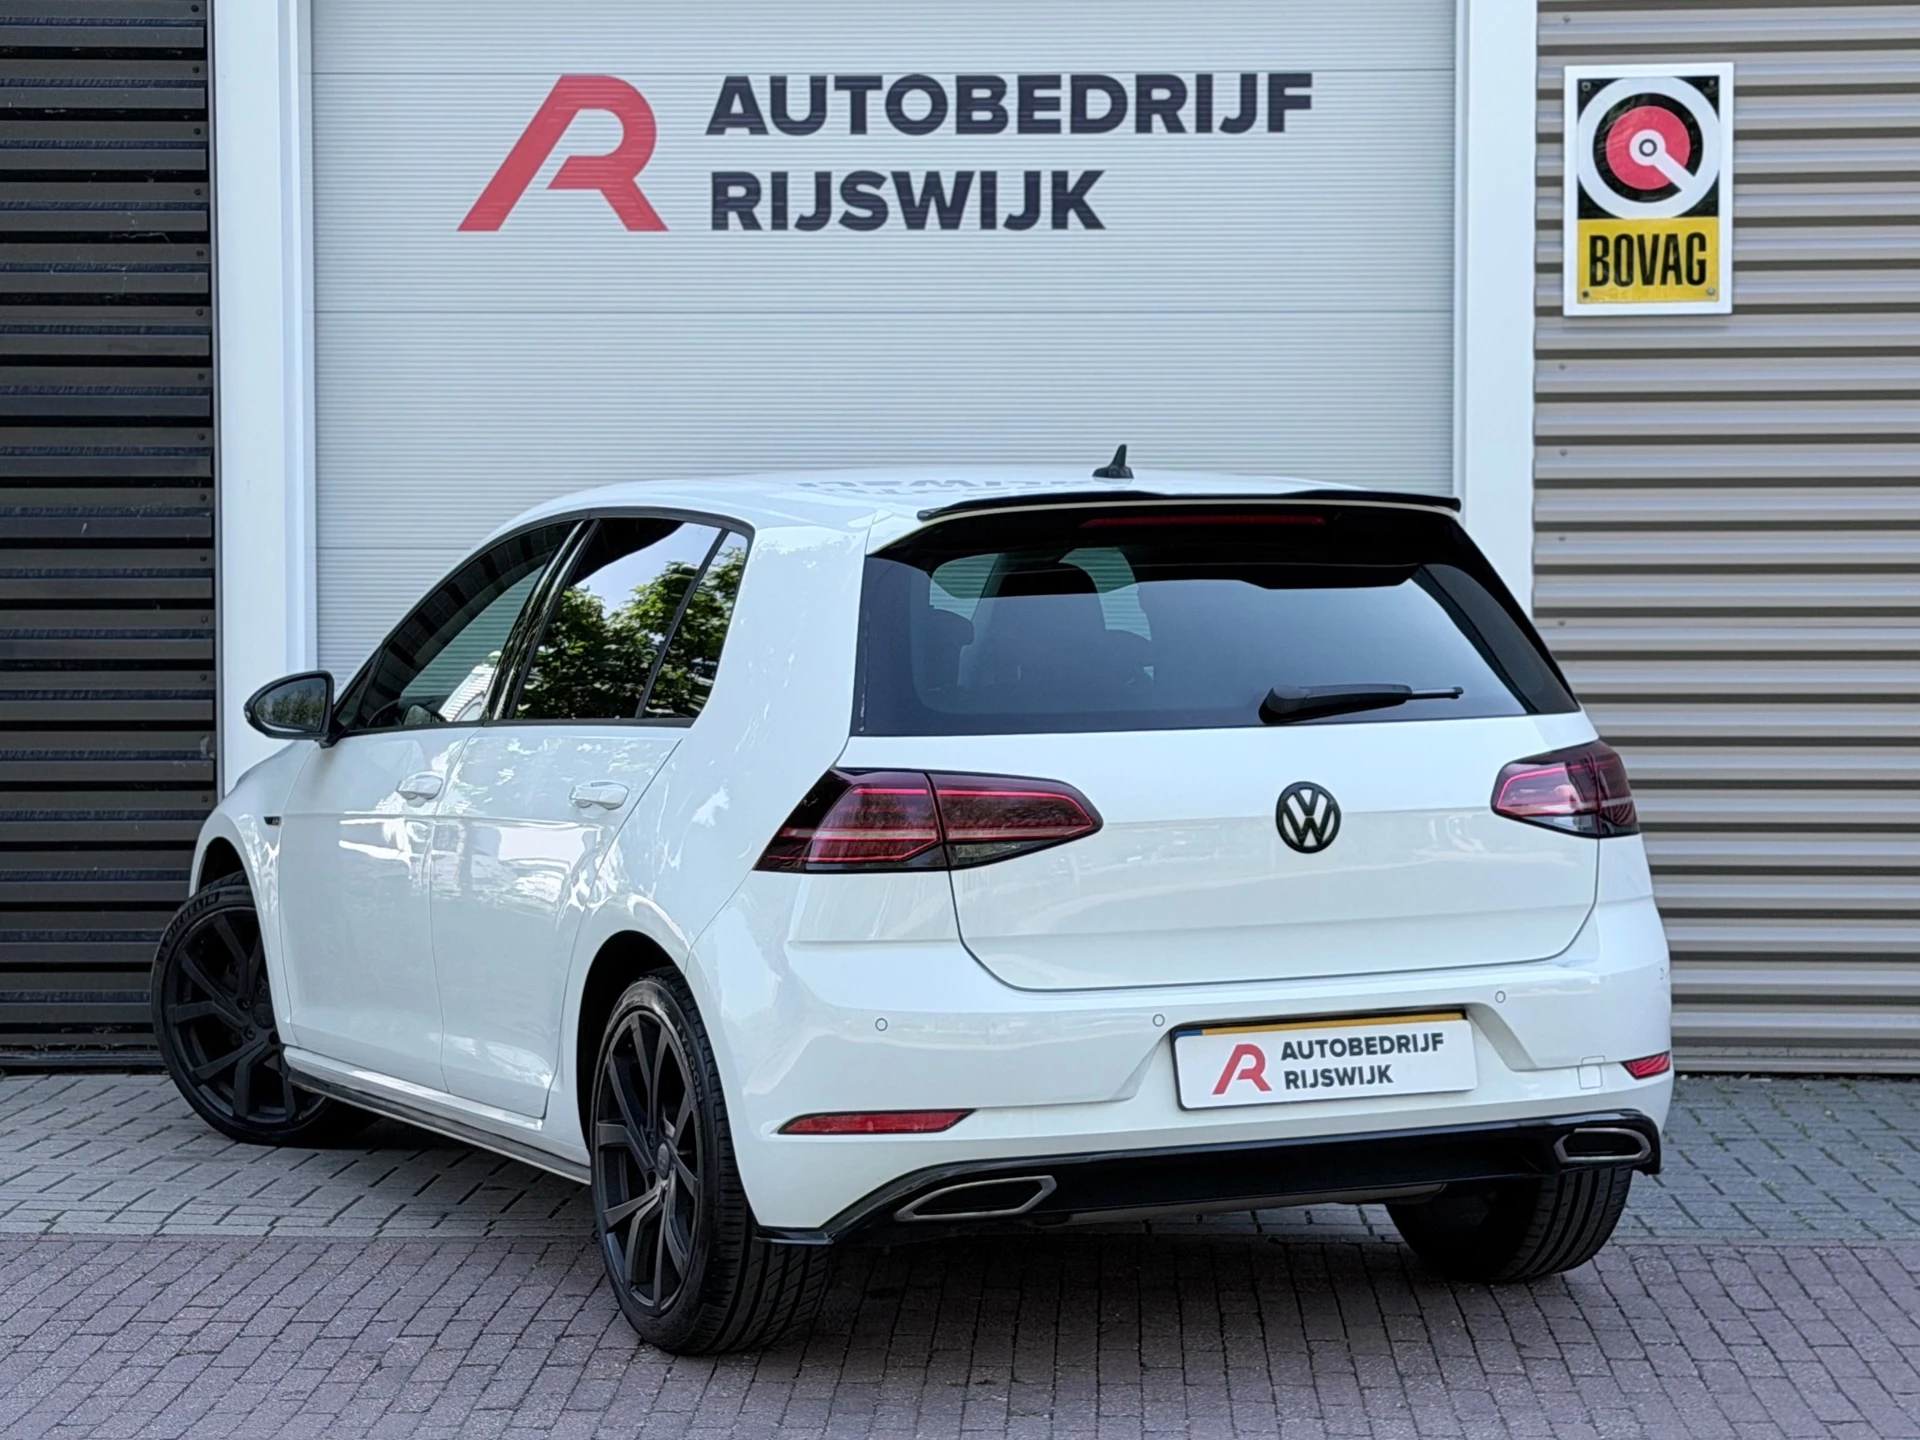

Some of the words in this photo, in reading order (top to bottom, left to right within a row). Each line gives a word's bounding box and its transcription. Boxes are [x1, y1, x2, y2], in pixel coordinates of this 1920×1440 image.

[705, 73, 1313, 136] AUTOBEDRIJF
[711, 169, 1106, 231] RIJSWIJK
[1589, 232, 1707, 287] BOVAG
[1277, 782, 1341, 853] VW
[1280, 1032, 1444, 1061] AUTOBEDRIJF
[1284, 1064, 1394, 1090] RIJSWIJK
